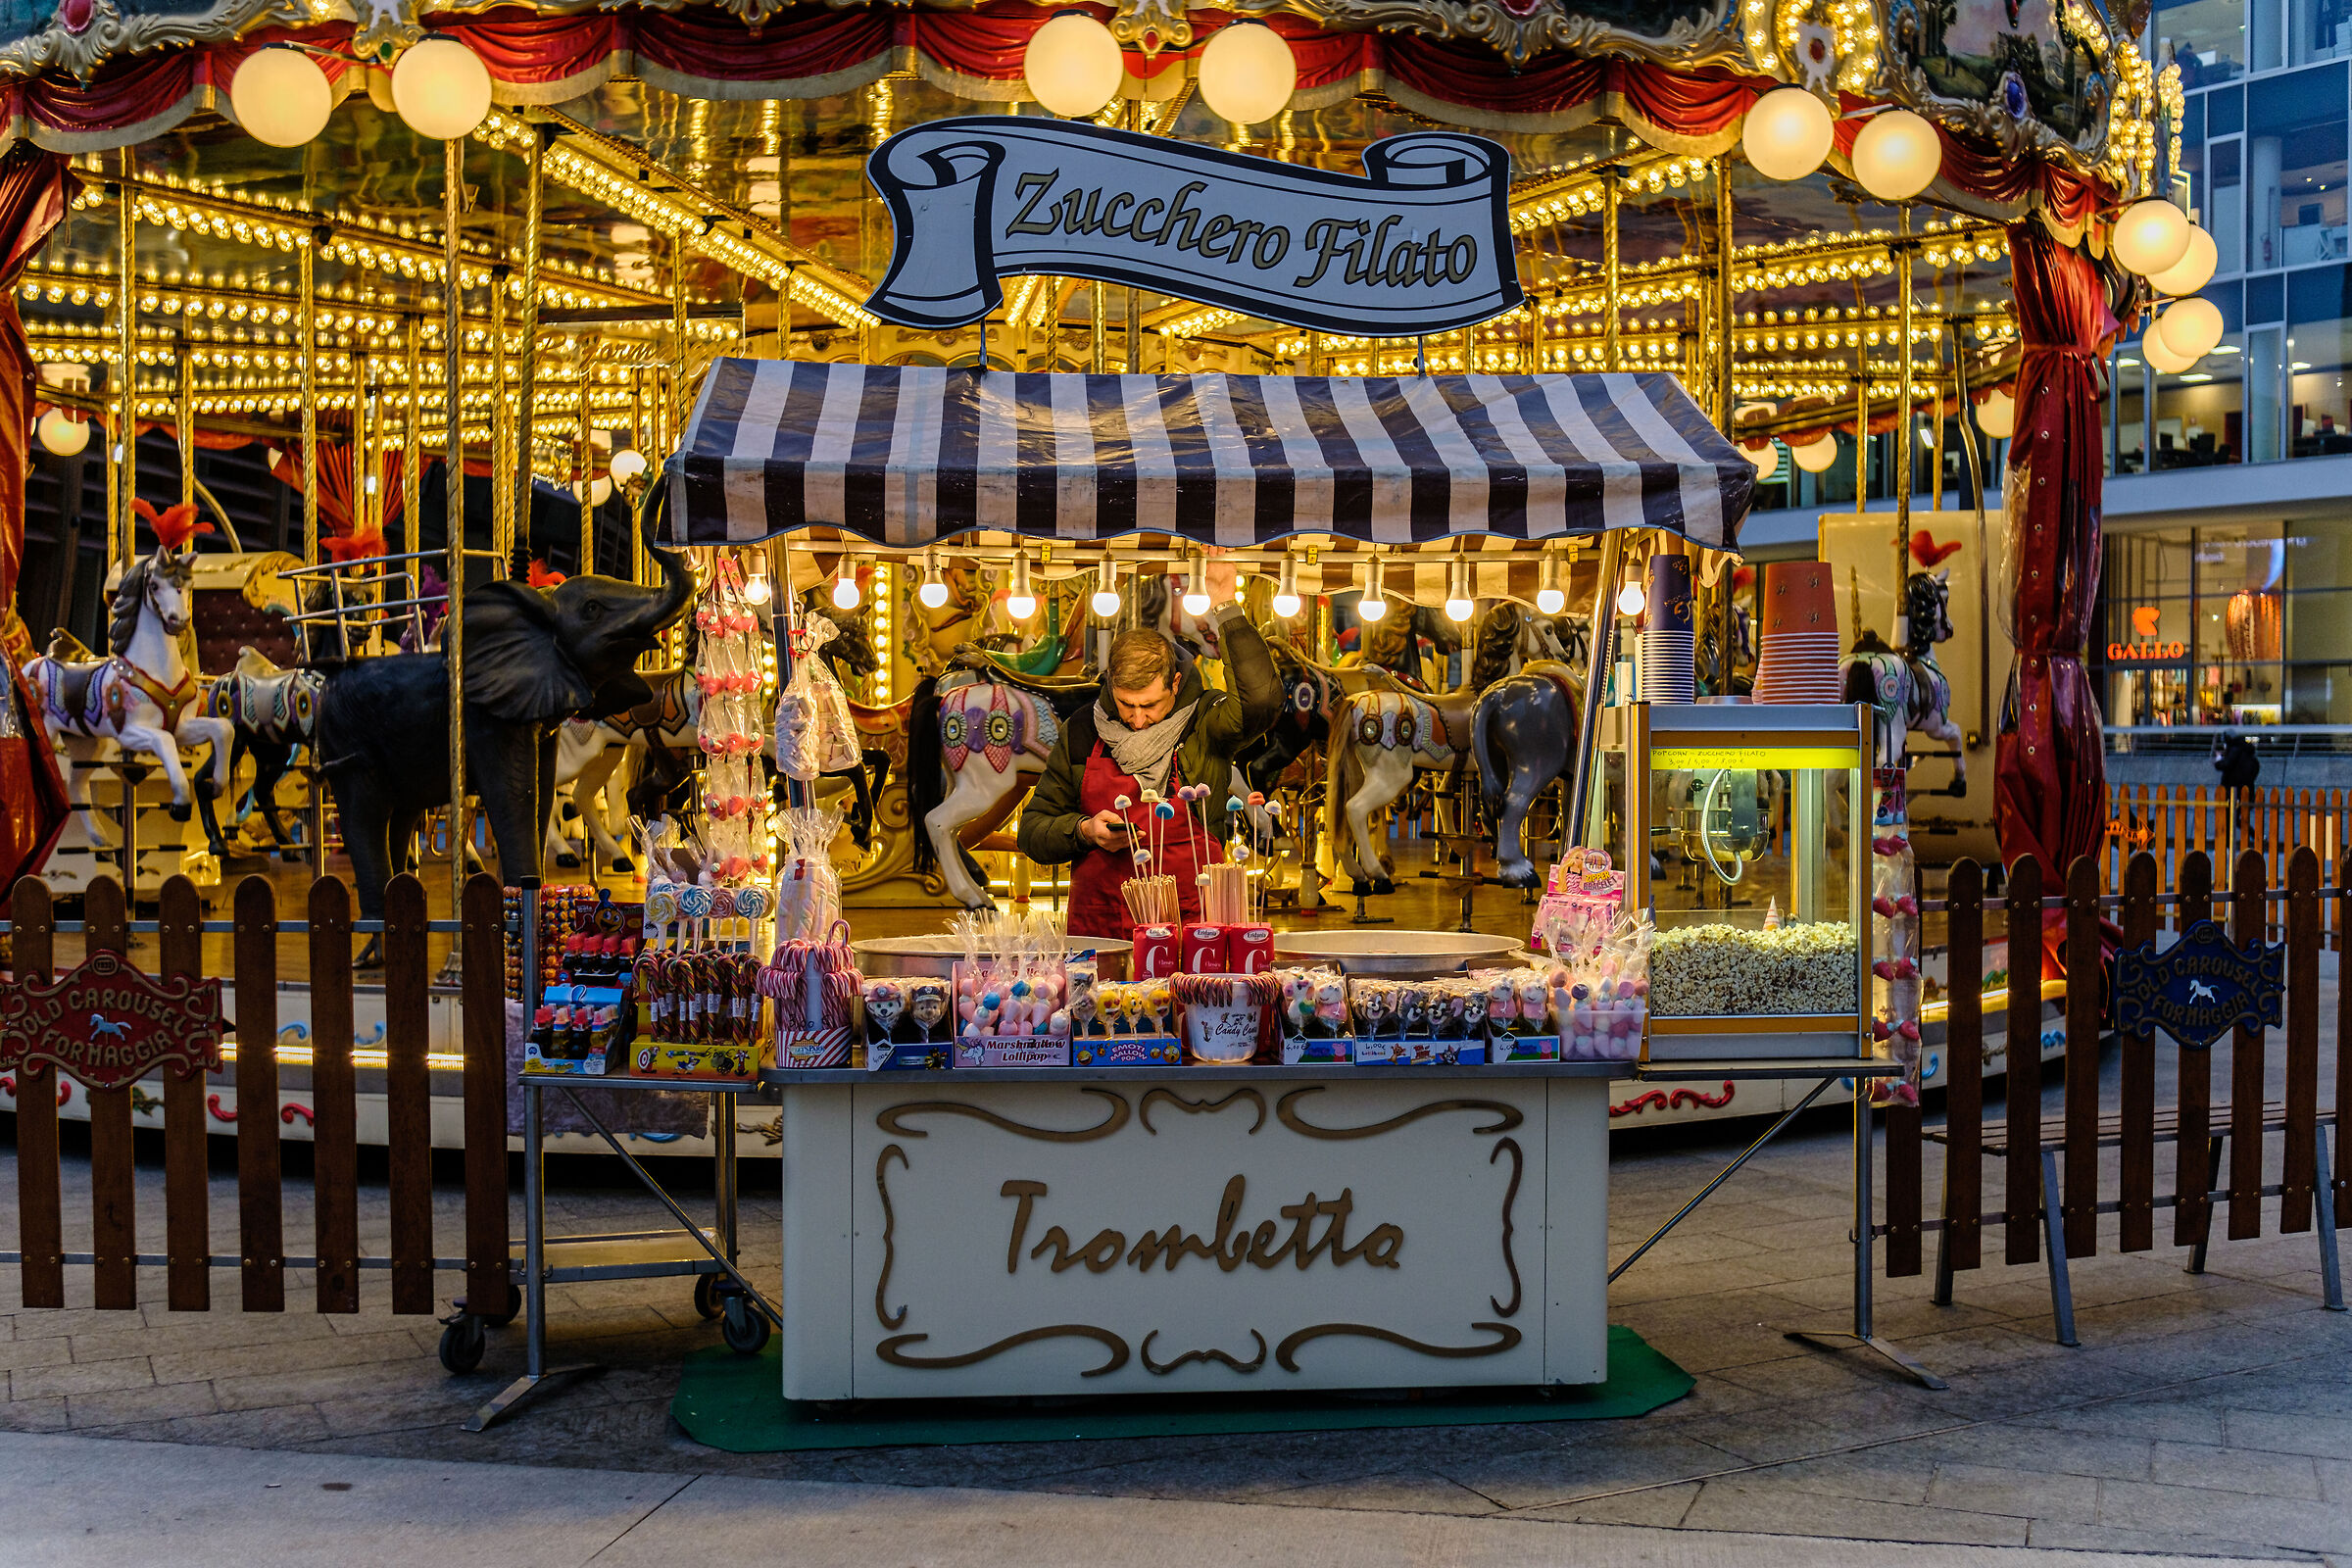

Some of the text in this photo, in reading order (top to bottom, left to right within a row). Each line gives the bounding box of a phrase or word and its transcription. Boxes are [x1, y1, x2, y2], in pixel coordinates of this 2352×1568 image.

[1005, 167, 1477, 289] Zucchero Filato
[2107, 641, 2184, 661] GALLO
[1586, 870, 1611, 883] ZIPPER
[2137, 956, 2259, 1001] OLD CAROUSEL
[23, 988, 187, 1037] OLD CAROUSEL
[2150, 991, 2250, 1027] FORMAGGIA
[1215, 1023, 1241, 1037] Candy
[40, 1029, 174, 1067] FORMAGGIA
[987, 1039, 1066, 1051] Marshmallow
[1111, 1043, 1146, 1054] EMOTI
[1003, 1052, 1048, 1062] Lollipop
[1110, 1050, 1148, 1061] MALLOW
